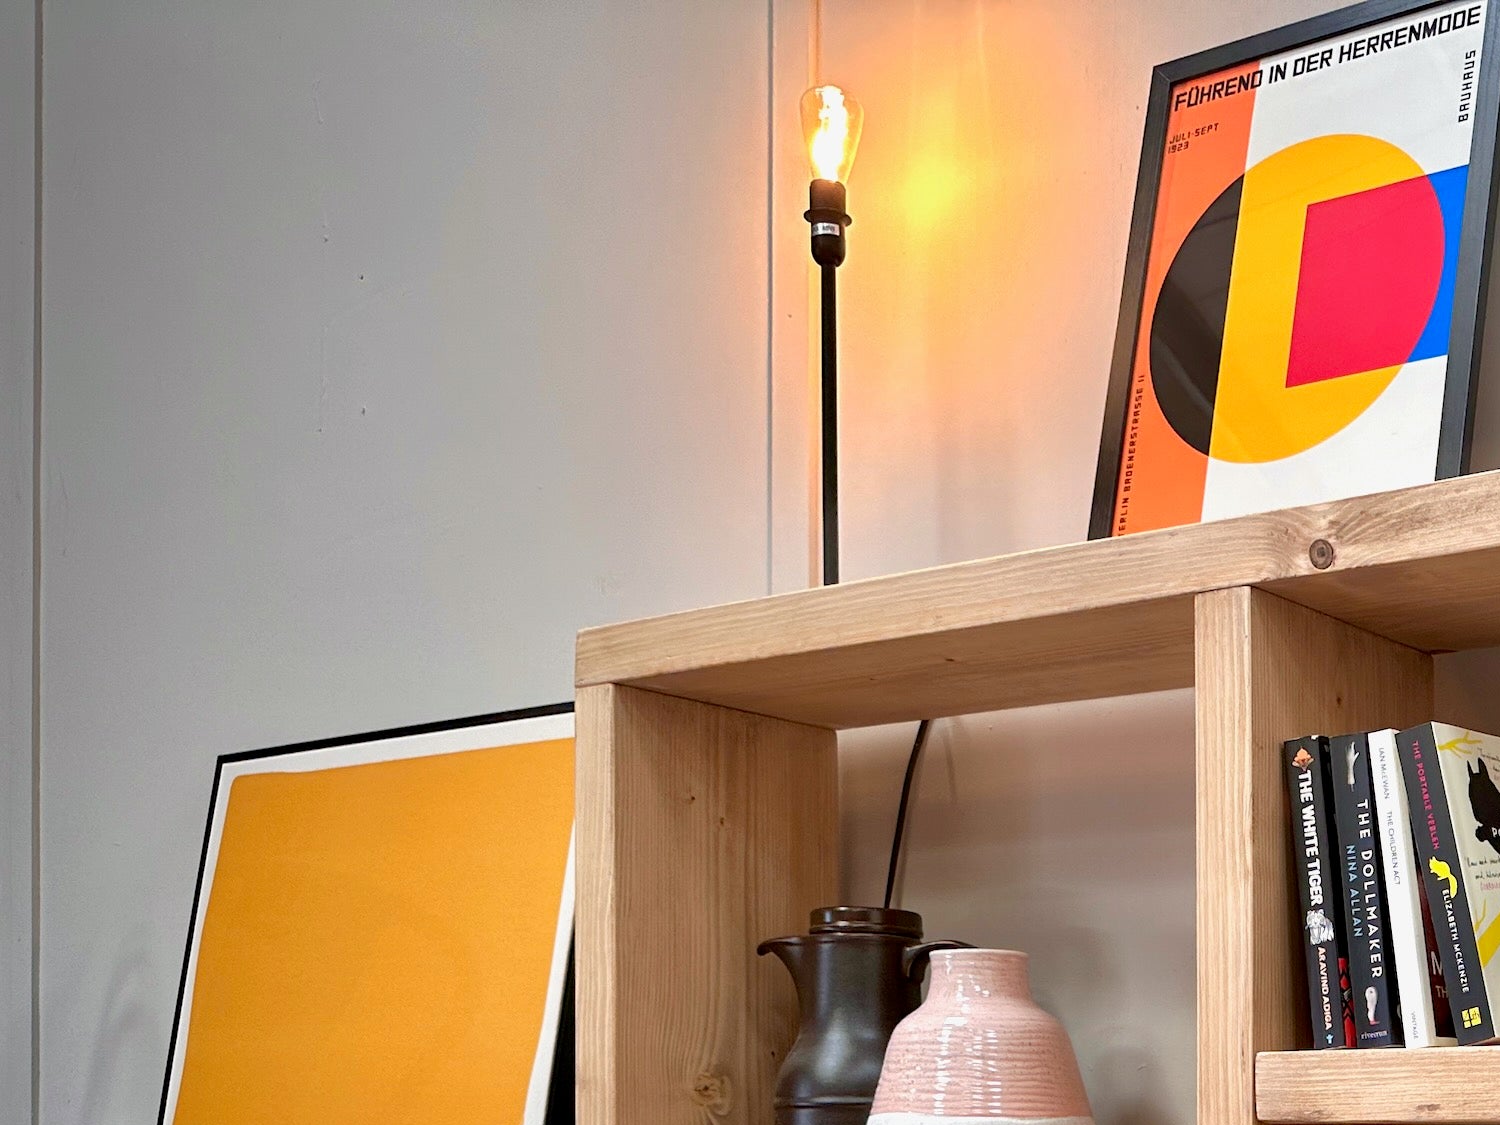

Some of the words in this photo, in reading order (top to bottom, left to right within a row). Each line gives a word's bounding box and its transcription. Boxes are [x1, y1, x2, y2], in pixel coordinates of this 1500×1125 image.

[1174, 69, 1263, 112] FÜHREND
[1268, 62, 1288, 84] IN
[1292, 48, 1333, 77] DER
[1338, 5, 1482, 64] HERRENMODE
[1458, 50, 1476, 123] BAUHAUS
[1168, 140, 1189, 154] 1923
[1117, 496, 1129, 537] ERLIN
[1411, 740, 1422, 760] THE
[1298, 769, 1313, 803] THE
[1415, 763, 1432, 811] PORTABLE
[1301, 804, 1319, 858] WHITE
[1357, 798, 1371, 839] THE
[1386, 810, 1394, 828] THE
[1426, 812, 1440, 850] VEBLEN
[1346, 845, 1358, 882] NINA
[1387, 828, 1399, 869] CHILDREN
[1307, 858, 1324, 907] TIGER
[1393, 871, 1401, 885] ACT
[1349, 888, 1363, 937] ALLAN
[1361, 849, 1383, 979] DOLLMAKER
[1441, 888, 1460, 941] ELIZABETH
[1452, 943, 1470, 994] MCKENZIE
[1317, 946, 1330, 995] ARAVIND
[1322, 996, 1333, 1031] ADIGA
